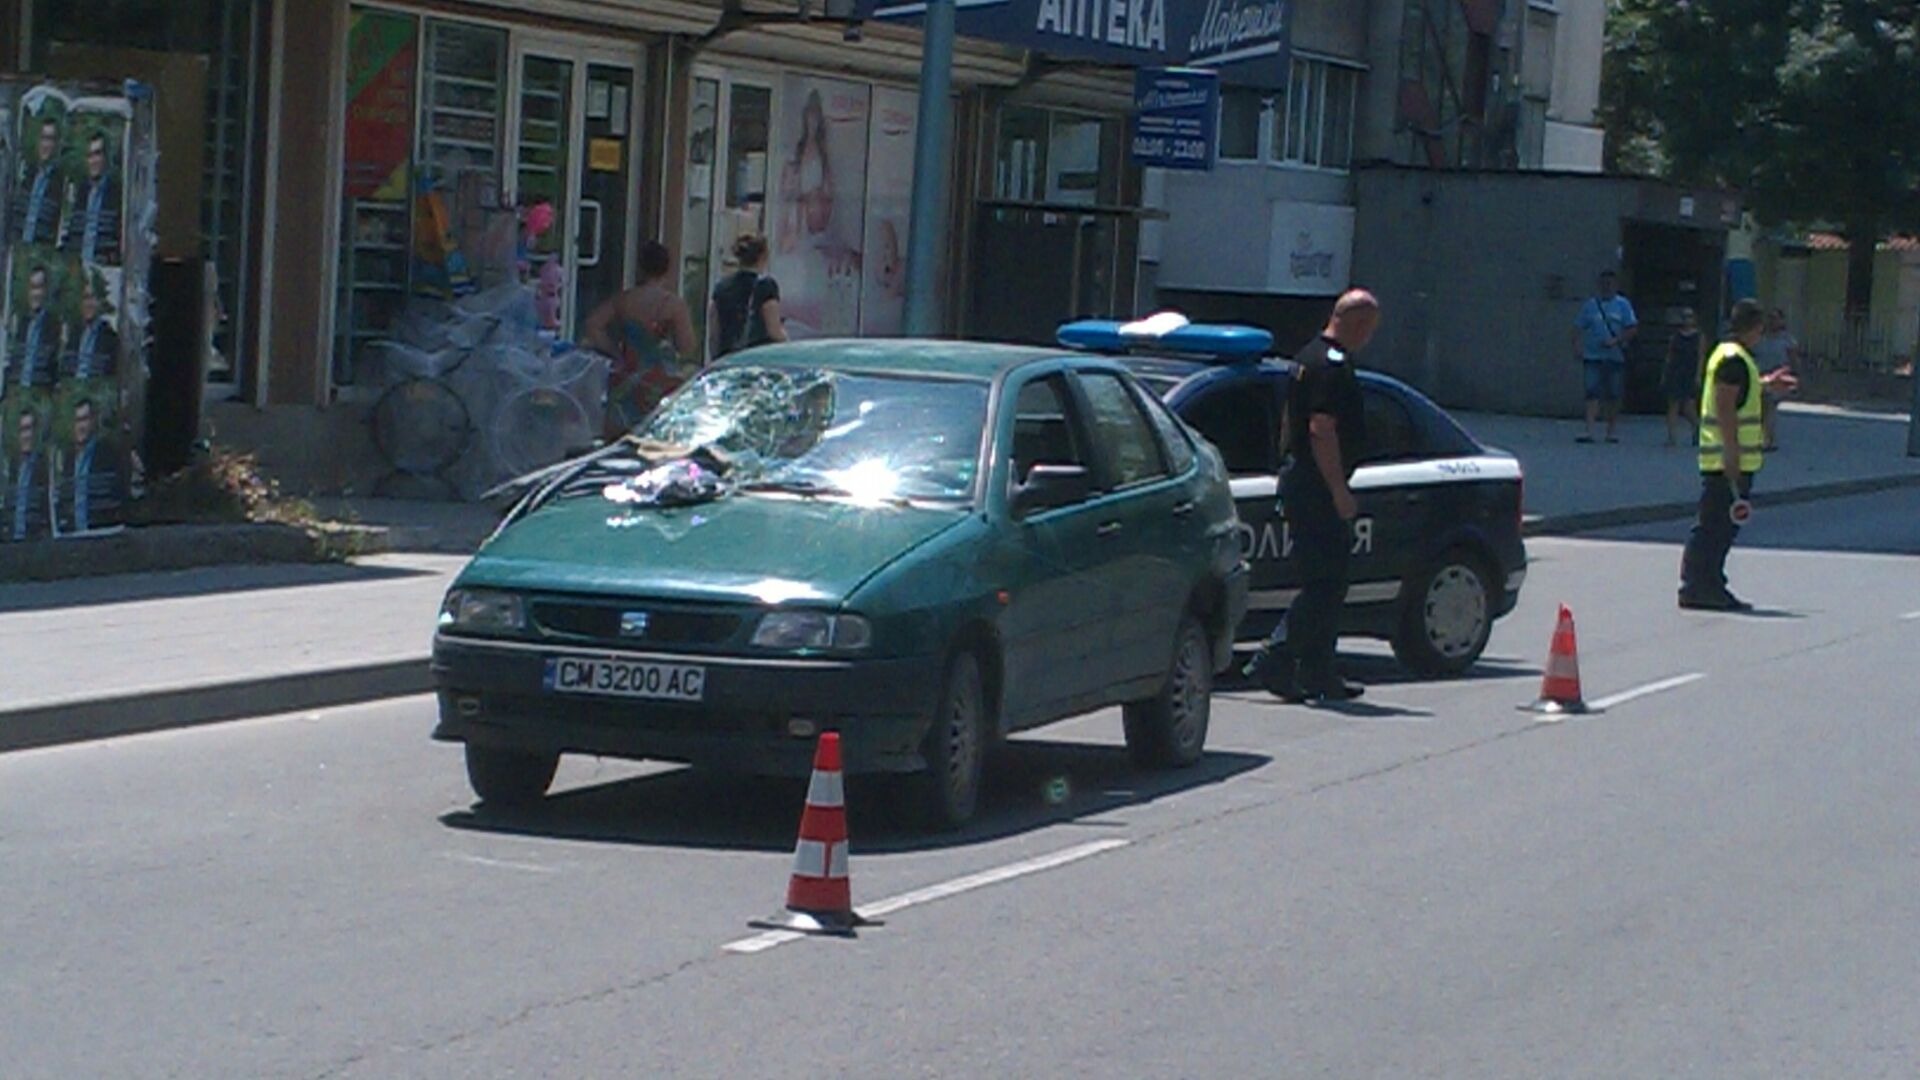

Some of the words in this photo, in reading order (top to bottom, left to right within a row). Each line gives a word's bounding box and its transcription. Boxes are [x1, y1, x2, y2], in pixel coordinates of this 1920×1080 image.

[1037, 0, 1166, 51] АПТЕКА
[560, 661, 594, 689] CM
[597, 664, 661, 693] 3200
[666, 669, 701, 696] AC
